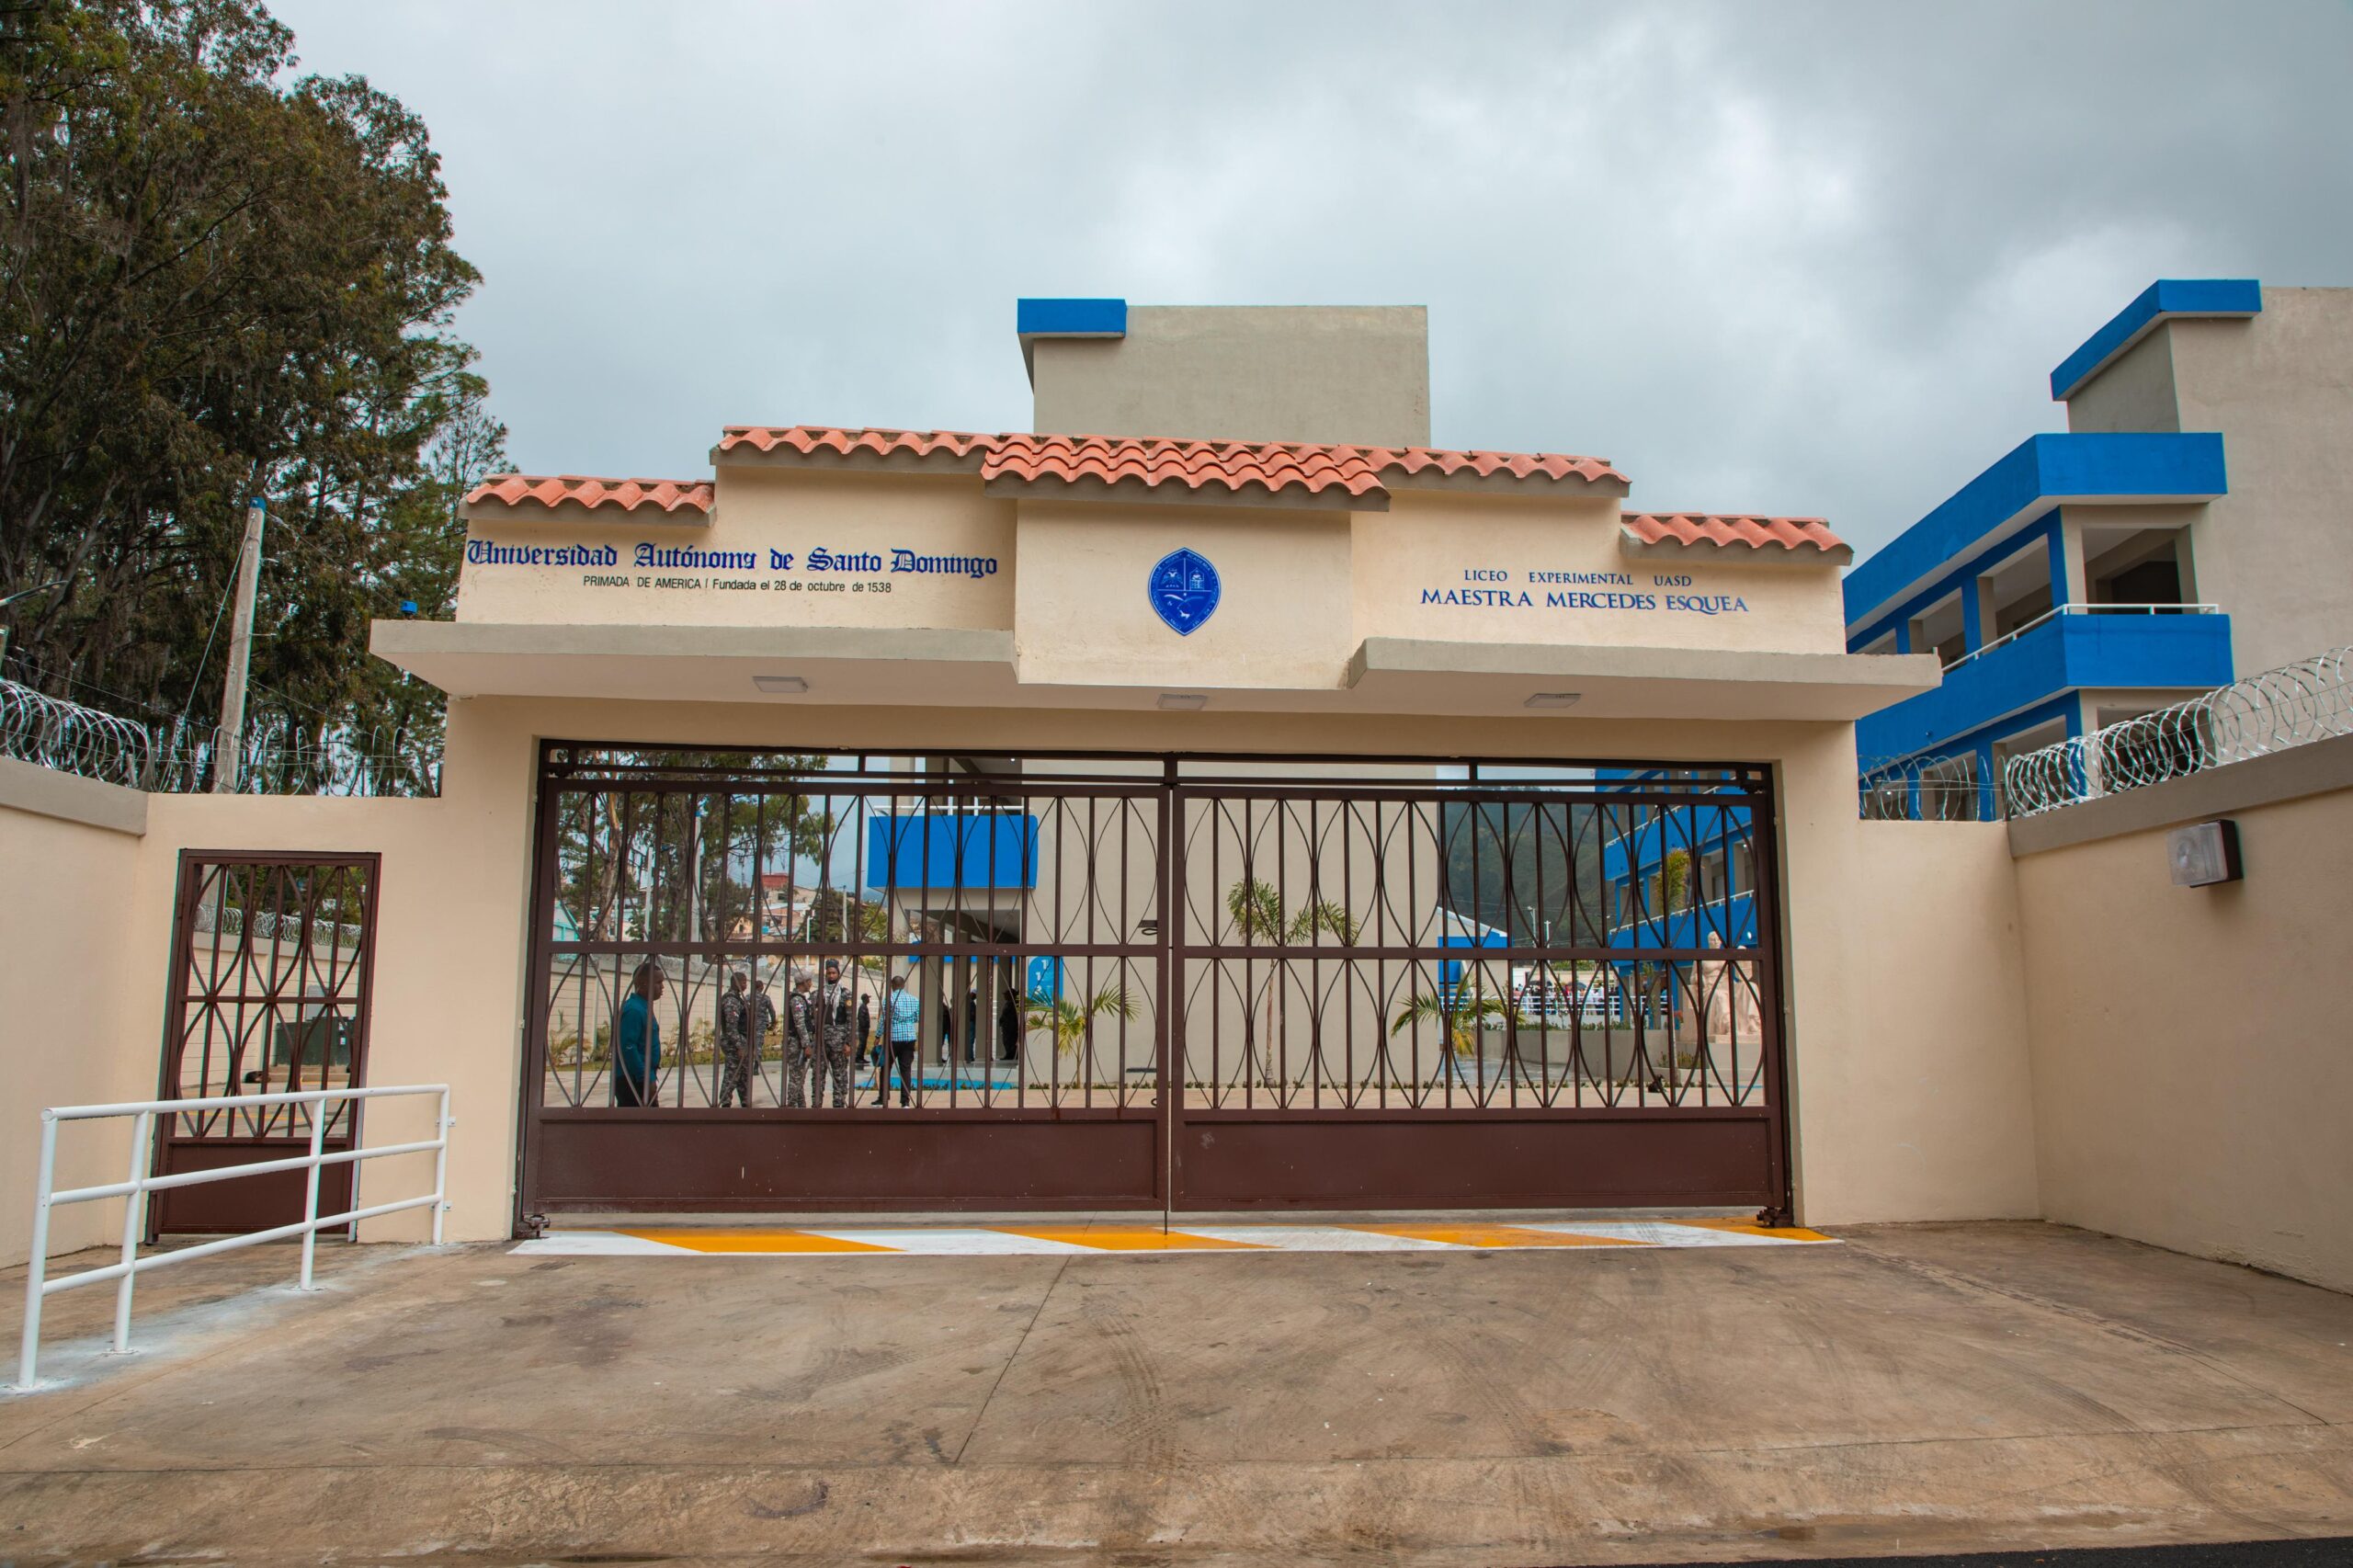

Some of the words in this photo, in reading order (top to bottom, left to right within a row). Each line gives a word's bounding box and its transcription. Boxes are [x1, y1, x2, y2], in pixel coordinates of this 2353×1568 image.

[468, 540, 618, 568] Universidad
[770, 549, 794, 571] de
[807, 547, 881, 574] Santo
[891, 549, 998, 579] Domingo
[583, 575, 630, 587] PRIMADA
[637, 576, 652, 588] DE
[654, 578, 701, 590] AMERICA
[712, 579, 756, 591] Fundada
[760, 580, 770, 591] el
[774, 580, 787, 592] 28
[790, 580, 802, 592] de
[807, 581, 846, 593] octubre
[852, 582, 865, 593] de
[867, 583, 892, 595] 1538
[1464, 569, 1508, 582] LICEO
[1529, 572, 1633, 585] EXPERIMENTAL
[1654, 574, 1691, 586] UASD
[1420, 588, 1535, 607] MAESTRA
[1546, 592, 1656, 610] MERCEDES
[1665, 595, 1749, 616] ESQUEA
